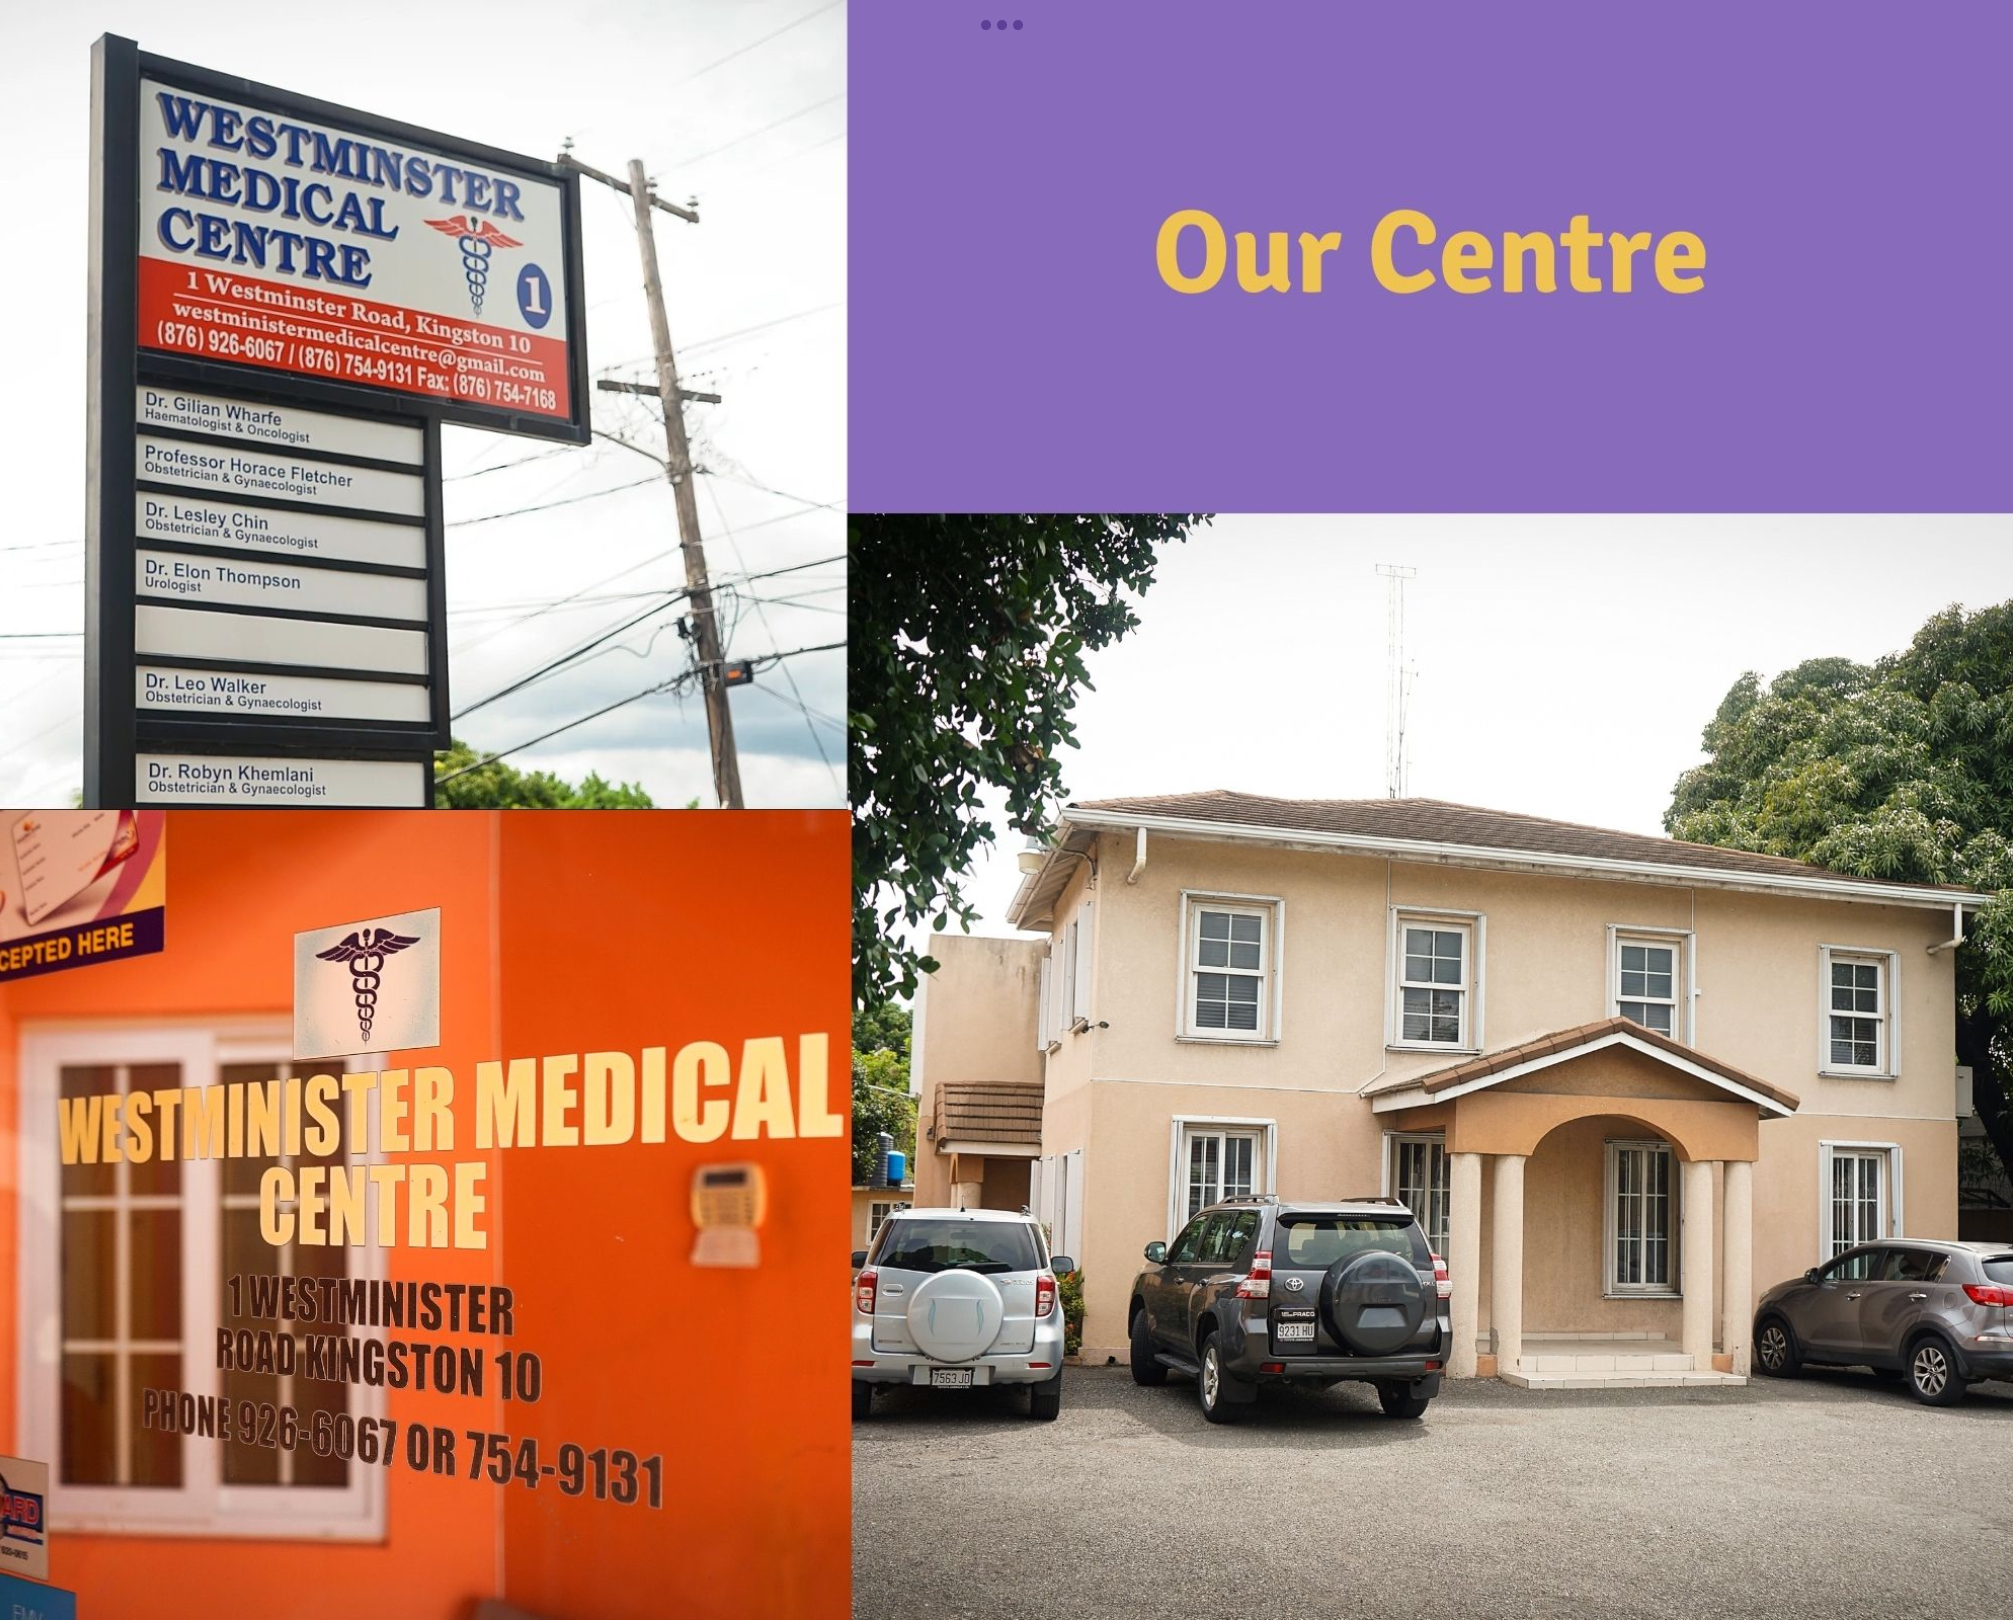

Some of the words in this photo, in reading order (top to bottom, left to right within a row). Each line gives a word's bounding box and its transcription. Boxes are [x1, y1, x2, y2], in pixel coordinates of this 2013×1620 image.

[156, 92, 525, 222] WESTMINSTER
[156, 148, 399, 241] MEDICAL
[157, 208, 372, 289] CENTRE
[525, 277, 545, 314] 1
[187, 272, 199, 291] 1
[205, 273, 346, 319] Westminster
[351, 304, 411, 335] Road,
[415, 316, 503, 351] Kingston
[510, 335, 531, 354] 10
[173, 303, 545, 383] westministermedicalcentre@gmail.com
[157, 321, 204, 352] (876)
[209, 332, 284, 362] 926-6067
[288, 345, 294, 363] /
[299, 345, 340, 374] (876)
[345, 353, 413, 386] 754-9131
[417, 370, 449, 392] Fax:
[453, 373, 491, 401] (876)
[494, 379, 556, 410] 754-7168
[145, 409, 232, 433] Haematologist
[236, 422, 243, 433] &
[247, 424, 310, 443] Oncologist
[146, 392, 167, 408] Dr.
[174, 397, 220, 417] Gilian
[226, 405, 282, 426] Wharfe
[145, 463, 219, 481] Obstetrician
[222, 472, 230, 483] &
[234, 474, 317, 495] Gynaecologist
[146, 445, 225, 470] Professor
[230, 458, 285, 478] Horace
[291, 466, 353, 488] Fletcher
[146, 502, 168, 518] Dr.
[174, 505, 226, 529] Lesley
[232, 512, 268, 530] Chin
[146, 519, 219, 537] Obstetrician
[223, 527, 232, 538] &
[235, 529, 318, 549] Gynaecologist
[146, 560, 168, 575] Dr.
[175, 564, 210, 580] Elon
[216, 568, 300, 590] Thompson
[146, 577, 201, 594] Urologist
[146, 674, 169, 689] Dr.
[175, 676, 205, 691] Leo
[211, 678, 266, 694] Walker
[146, 691, 221, 706] Obstetrician
[225, 695, 234, 706] &
[238, 696, 322, 712] Gynaecologist
[149, 763, 172, 778] Dr.
[178, 765, 232, 783] Robyn
[239, 766, 313, 782] Khemlani
[149, 781, 225, 794] Obstetrician
[229, 783, 237, 794] &
[242, 783, 326, 798] Gynaecologist
[78, 923, 134, 956] HERE
[58, 1065, 455, 1165] WESTMINISTER
[476, 1033, 844, 1149] MEDICAL
[260, 1162, 487, 1250] CENTRE
[228, 1274, 242, 1316] 1
[250, 1274, 514, 1336] WESTMINISTER
[1279, 1326, 1300, 1336] 9231
[1302, 1326, 1313, 1336] HU
[217, 1327, 296, 1376] ROAD
[304, 1335, 483, 1397] KINGSTON
[495, 1351, 542, 1403] 10
[934, 1373, 956, 1383] 7563
[143, 1388, 231, 1440] PHONE
[238, 1400, 396, 1466] 926-6067
[406, 1423, 456, 1476] OR
[466, 1431, 663, 1510] 754-9131
[0, 1494, 39, 1524] ARD
